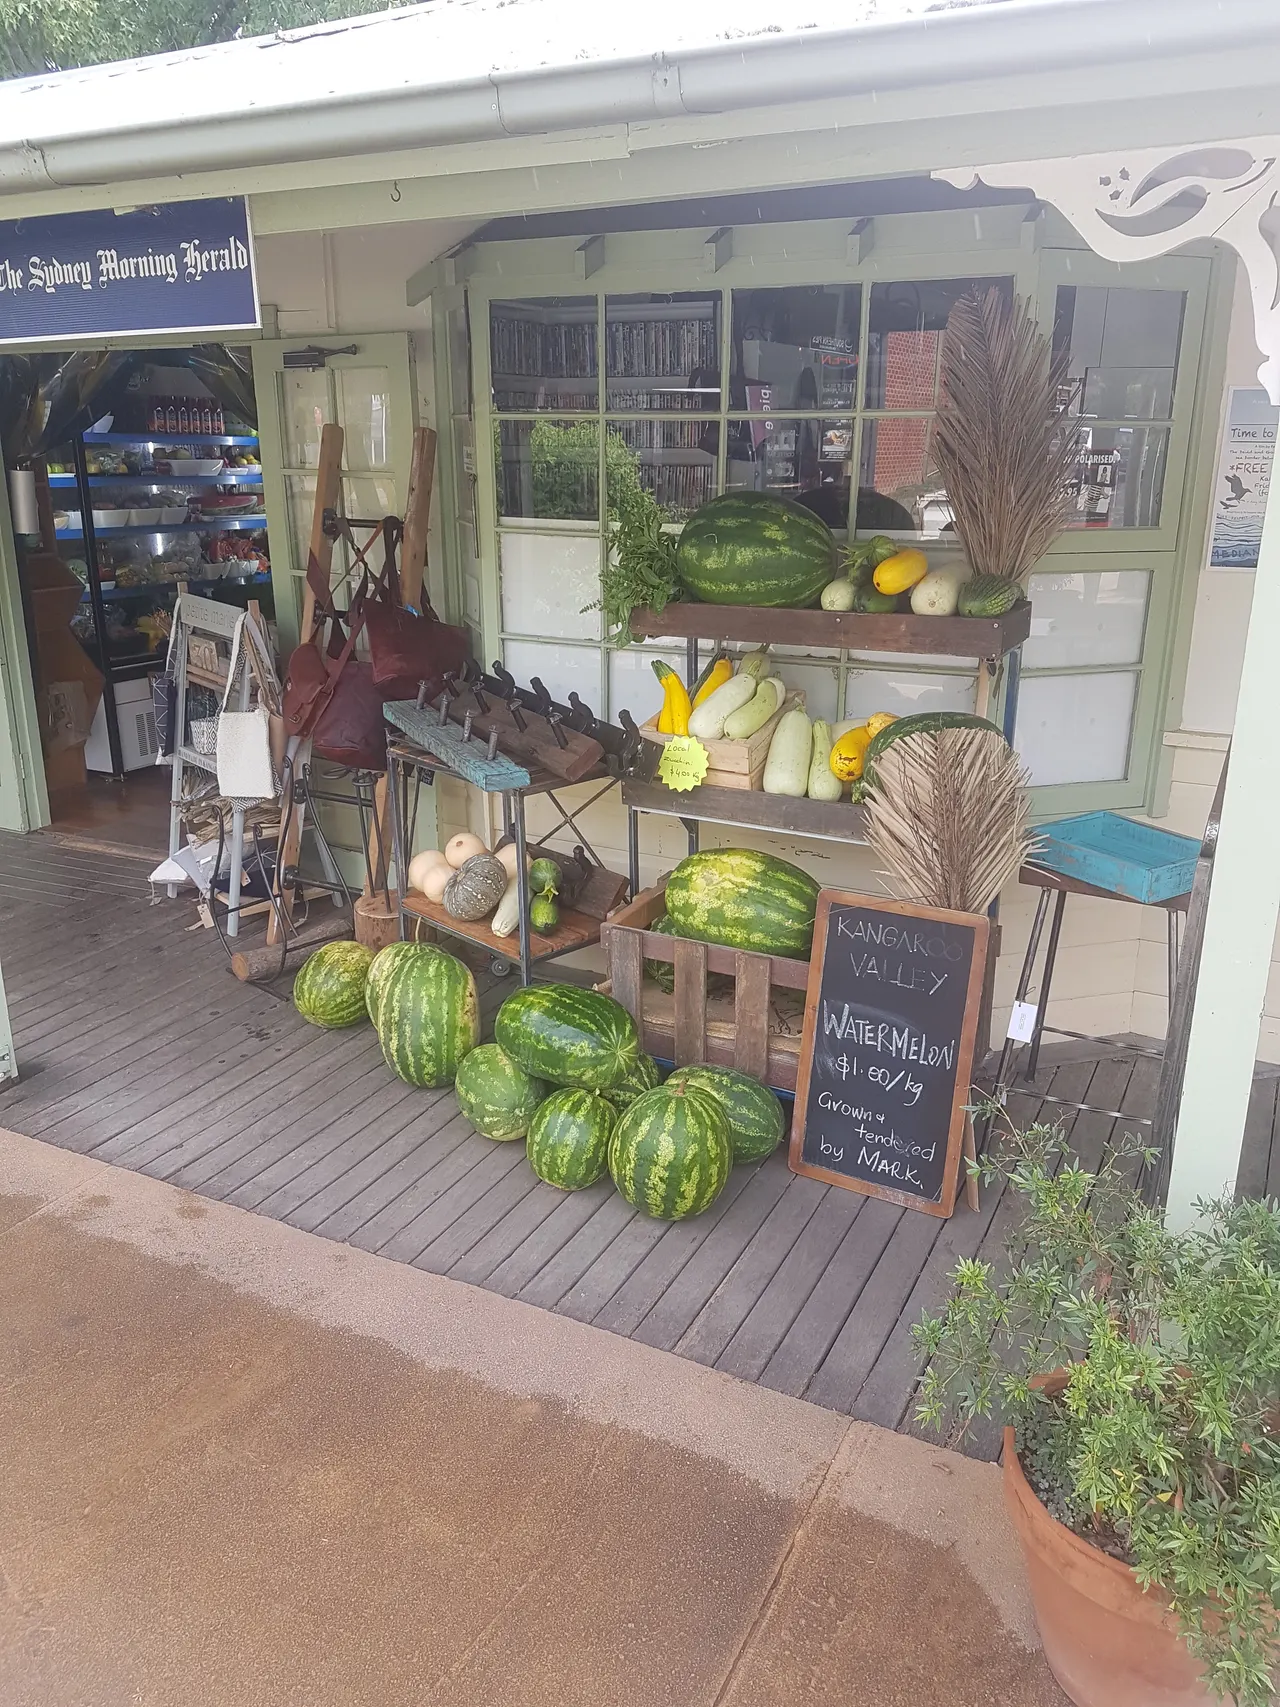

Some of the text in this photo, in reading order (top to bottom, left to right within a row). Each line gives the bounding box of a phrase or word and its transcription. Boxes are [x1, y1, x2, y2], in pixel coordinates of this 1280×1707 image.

[0, 235, 248, 296] The Sydney Morning Herald
[1231, 427, 1274, 438] Time to
[837, 916, 964, 961] KANGAROO
[849, 953, 948, 995] VALLEY
[823, 999, 956, 1070] WATERMELON
[818, 1091, 872, 1121] Grown
[820, 1135, 844, 1162] by
